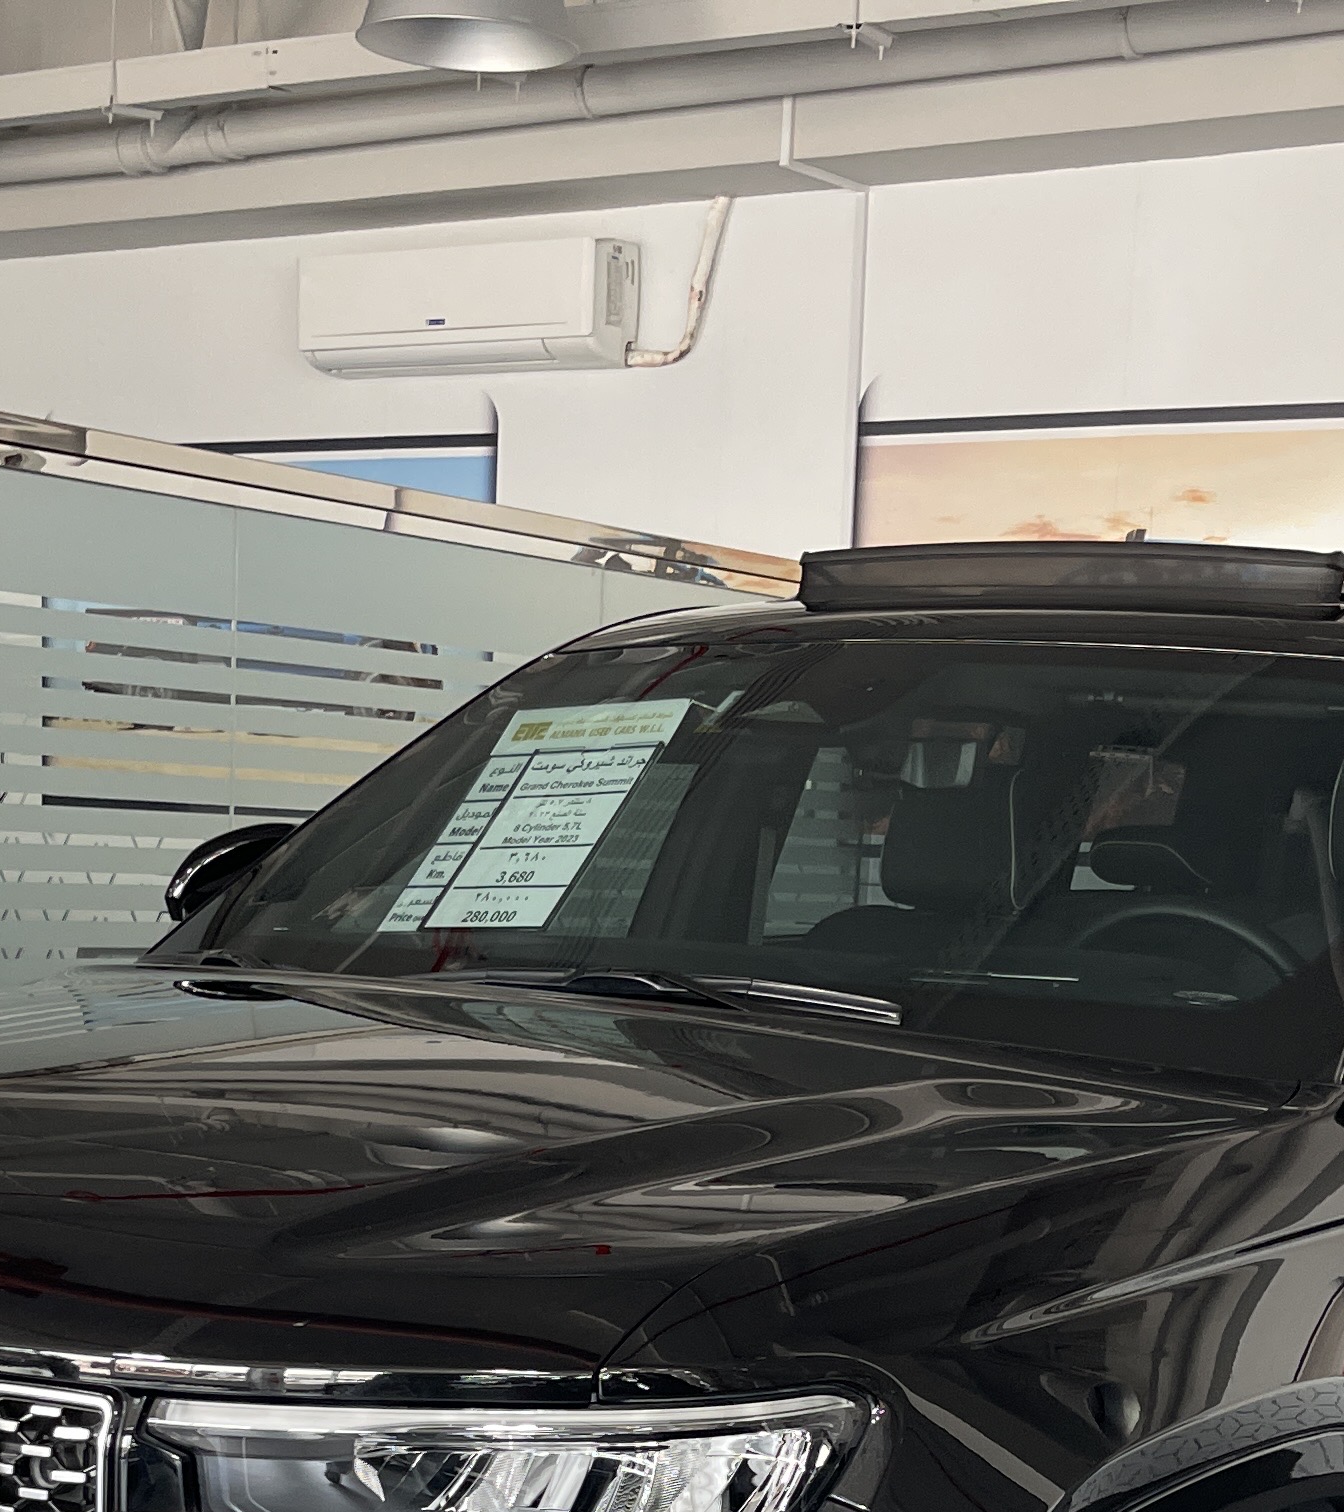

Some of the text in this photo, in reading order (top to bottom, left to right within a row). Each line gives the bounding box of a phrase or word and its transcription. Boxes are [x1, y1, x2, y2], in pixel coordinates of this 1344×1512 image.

[588, 726, 613, 738] USED
[614, 725, 637, 736] CARS
[478, 783, 510, 794] Name
[520, 776, 634, 792] Grand Cherokee Summit
[448, 825, 484, 838] Model
[521, 823, 562, 834] Cylinder
[501, 833, 580, 845] Model Year 2023
[495, 870, 536, 885] 3,680
[388, 911, 414, 922] Price
[461, 910, 518, 925] 280,000
